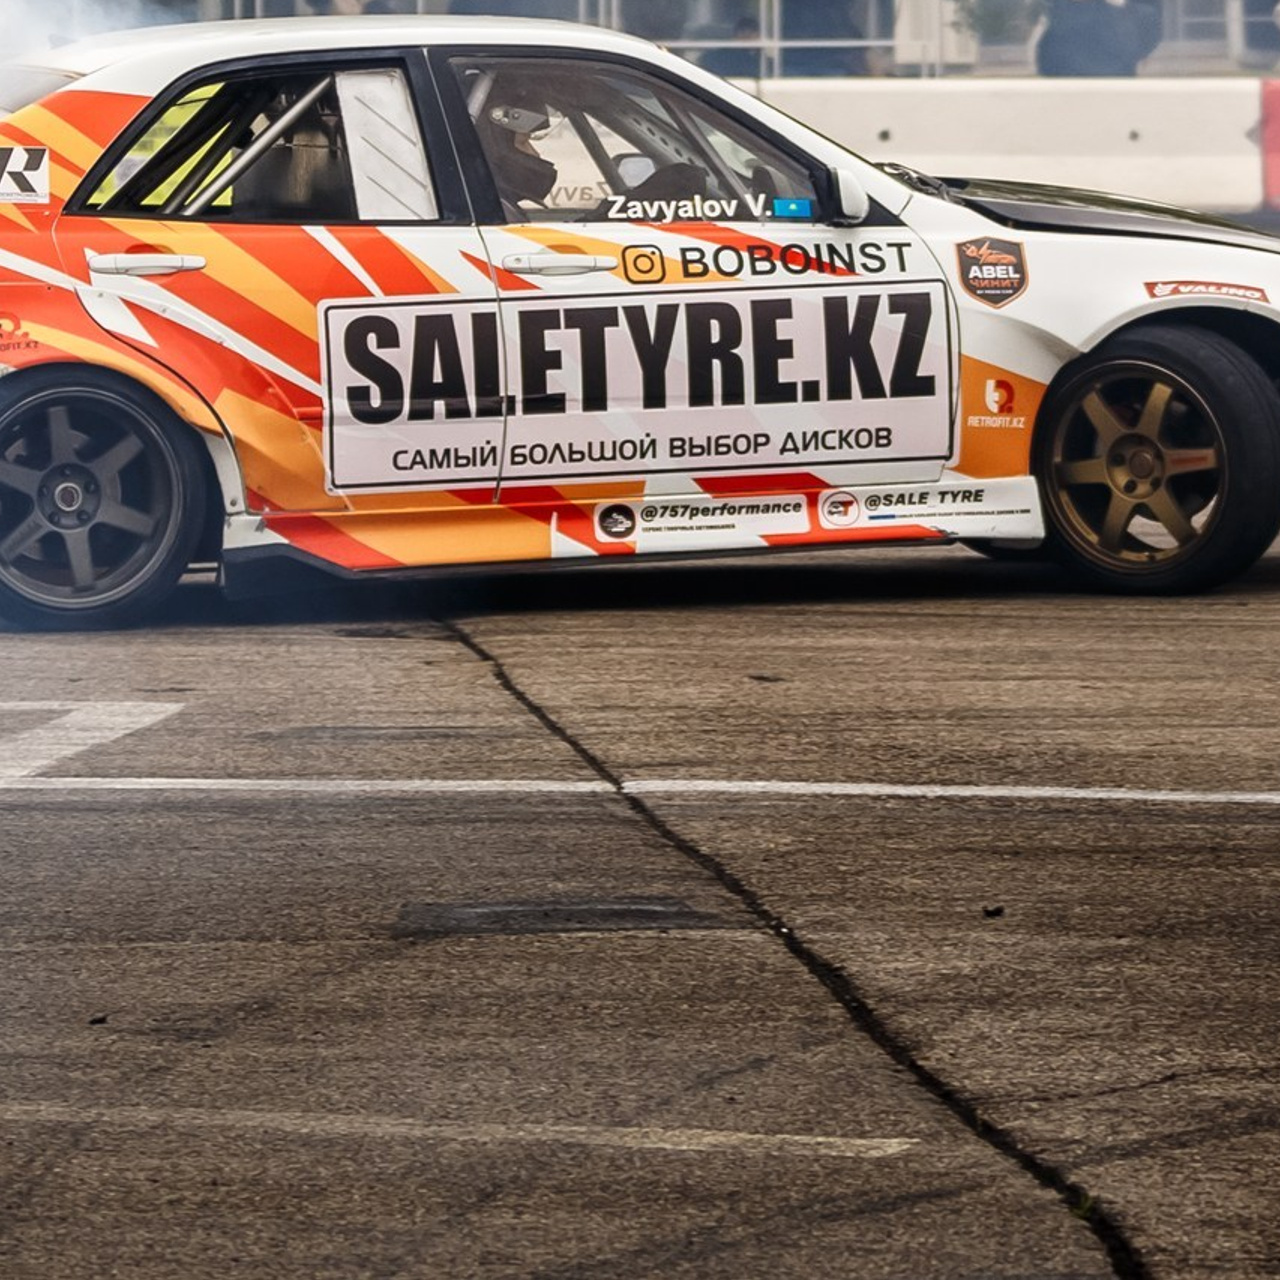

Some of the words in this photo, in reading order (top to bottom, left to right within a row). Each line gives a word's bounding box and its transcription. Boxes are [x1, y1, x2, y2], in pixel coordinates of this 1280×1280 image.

[607, 194, 738, 224] Zavyalov
[744, 193, 772, 218] V.
[680, 242, 912, 278] BOBOINST
[968, 265, 1021, 279] ABEL
[1178, 284, 1262, 299] VALINO
[343, 291, 937, 426] SALETYRE.KZ
[392, 440, 497, 470] САМЫЙ
[510, 433, 657, 466] БОЛЬШОЙ
[669, 433, 770, 458] ВЫБОР
[779, 427, 892, 455] ДИСКОВ
[640, 501, 802, 522] @757performance
